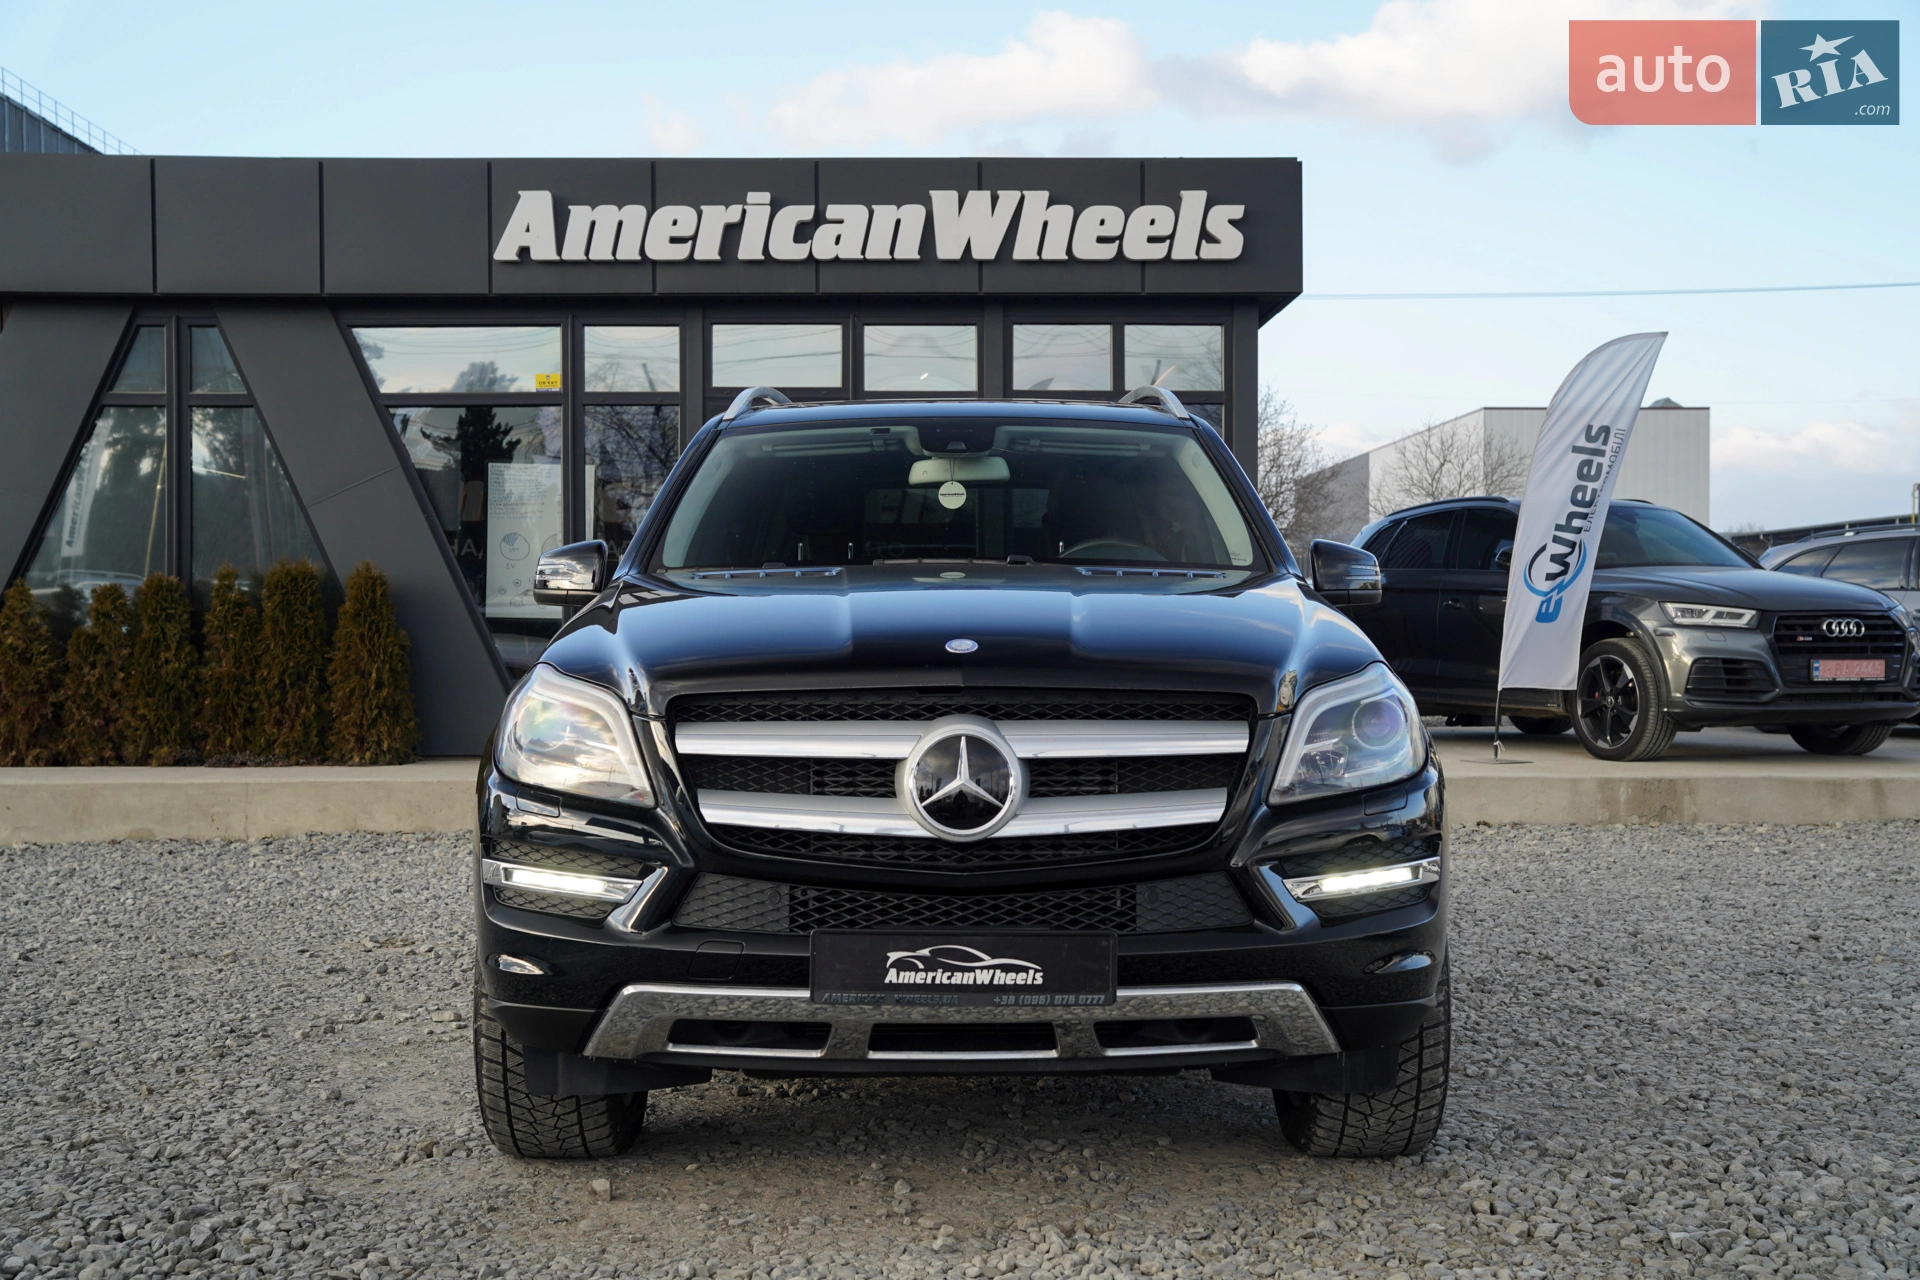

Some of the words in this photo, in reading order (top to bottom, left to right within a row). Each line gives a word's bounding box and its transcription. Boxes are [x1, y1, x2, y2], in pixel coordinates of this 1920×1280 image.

[493, 188, 1246, 263] AmericanWheels
[884, 968, 1044, 985] AmericanWheels
[994, 995, 1016, 1005] +38
[1078, 995, 1105, 1005] 0777
